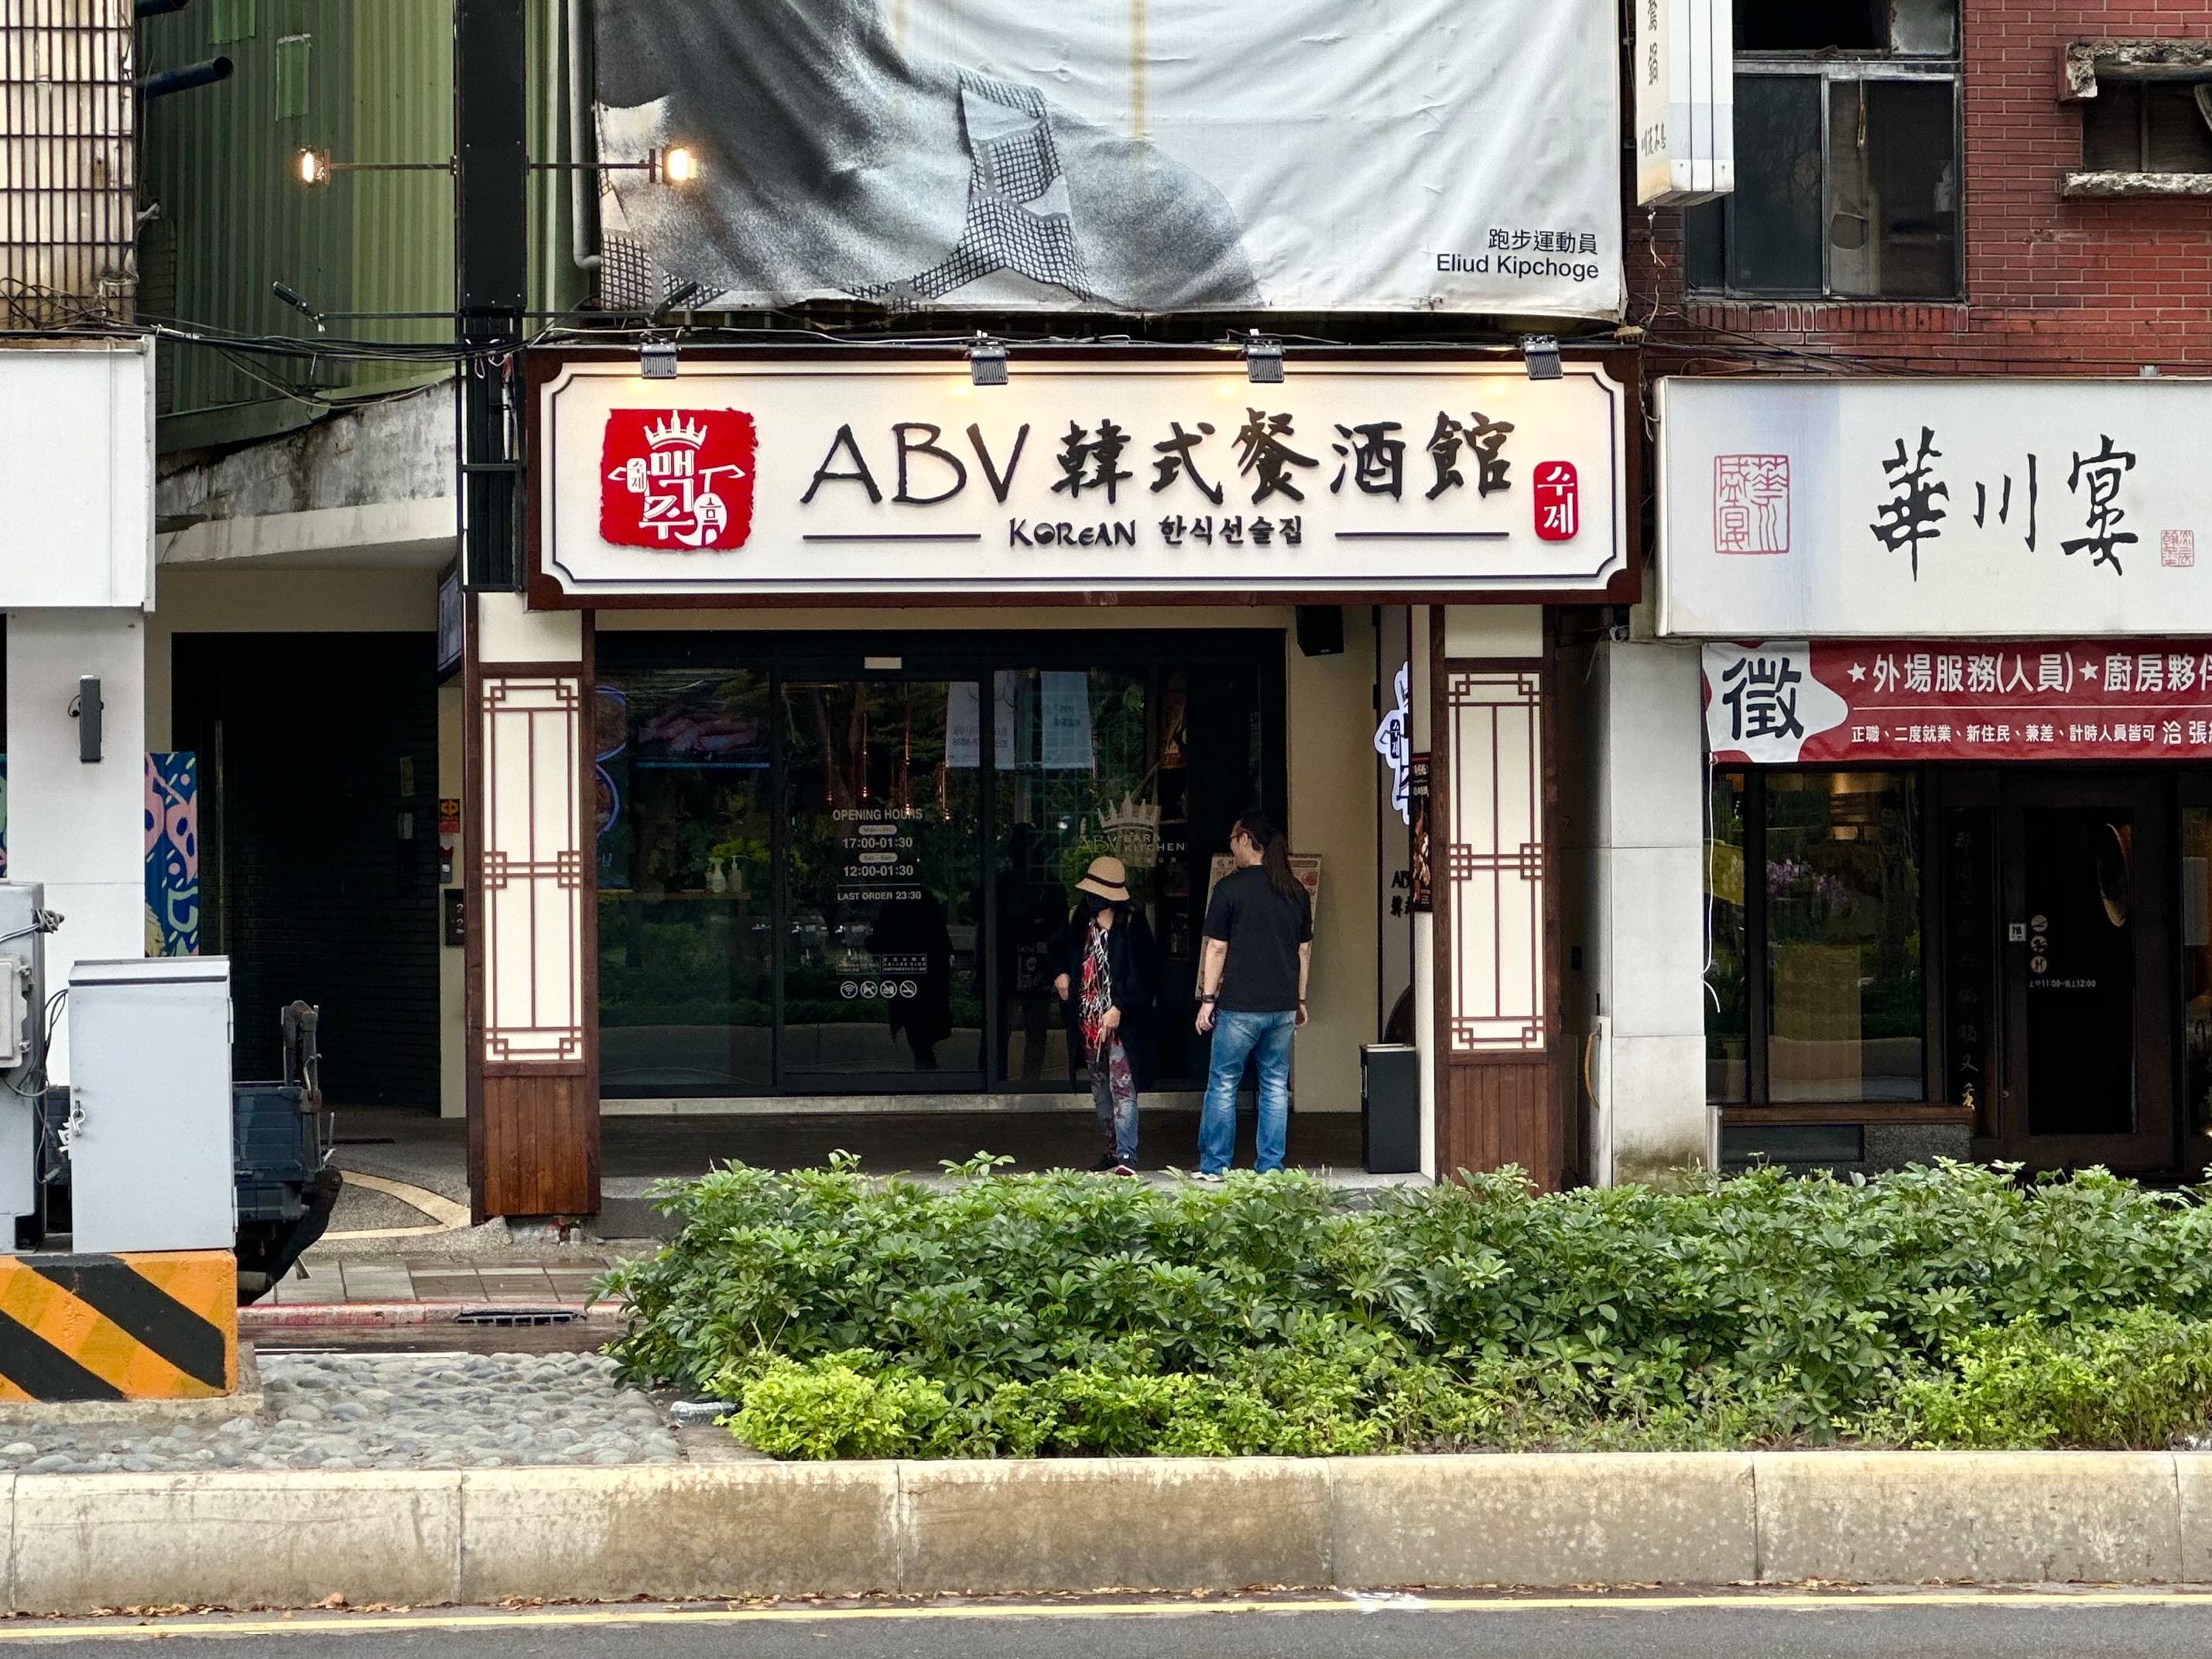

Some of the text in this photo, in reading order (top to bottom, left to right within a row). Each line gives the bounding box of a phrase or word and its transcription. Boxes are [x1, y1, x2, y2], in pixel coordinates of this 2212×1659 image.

[1488, 229, 1598, 255] 跑步運動員
[1436, 253, 1599, 282] Eliud Kipchoge
[800, 408, 1515, 505] ABV 韓式餐酒館
[1870, 426, 2138, 582] 華川宴
[1722, 657, 1805, 741] 徵
[2162, 720, 2182, 744] 洽
[2189, 720, 2212, 744] 張
[833, 808, 923, 820] OPENING HOURS
[842, 836, 913, 849] 17:00-01:30
[843, 864, 914, 877] 12:00-01:30
[837, 892, 860, 901] LAST
[895, 891, 922, 900] 23:30
